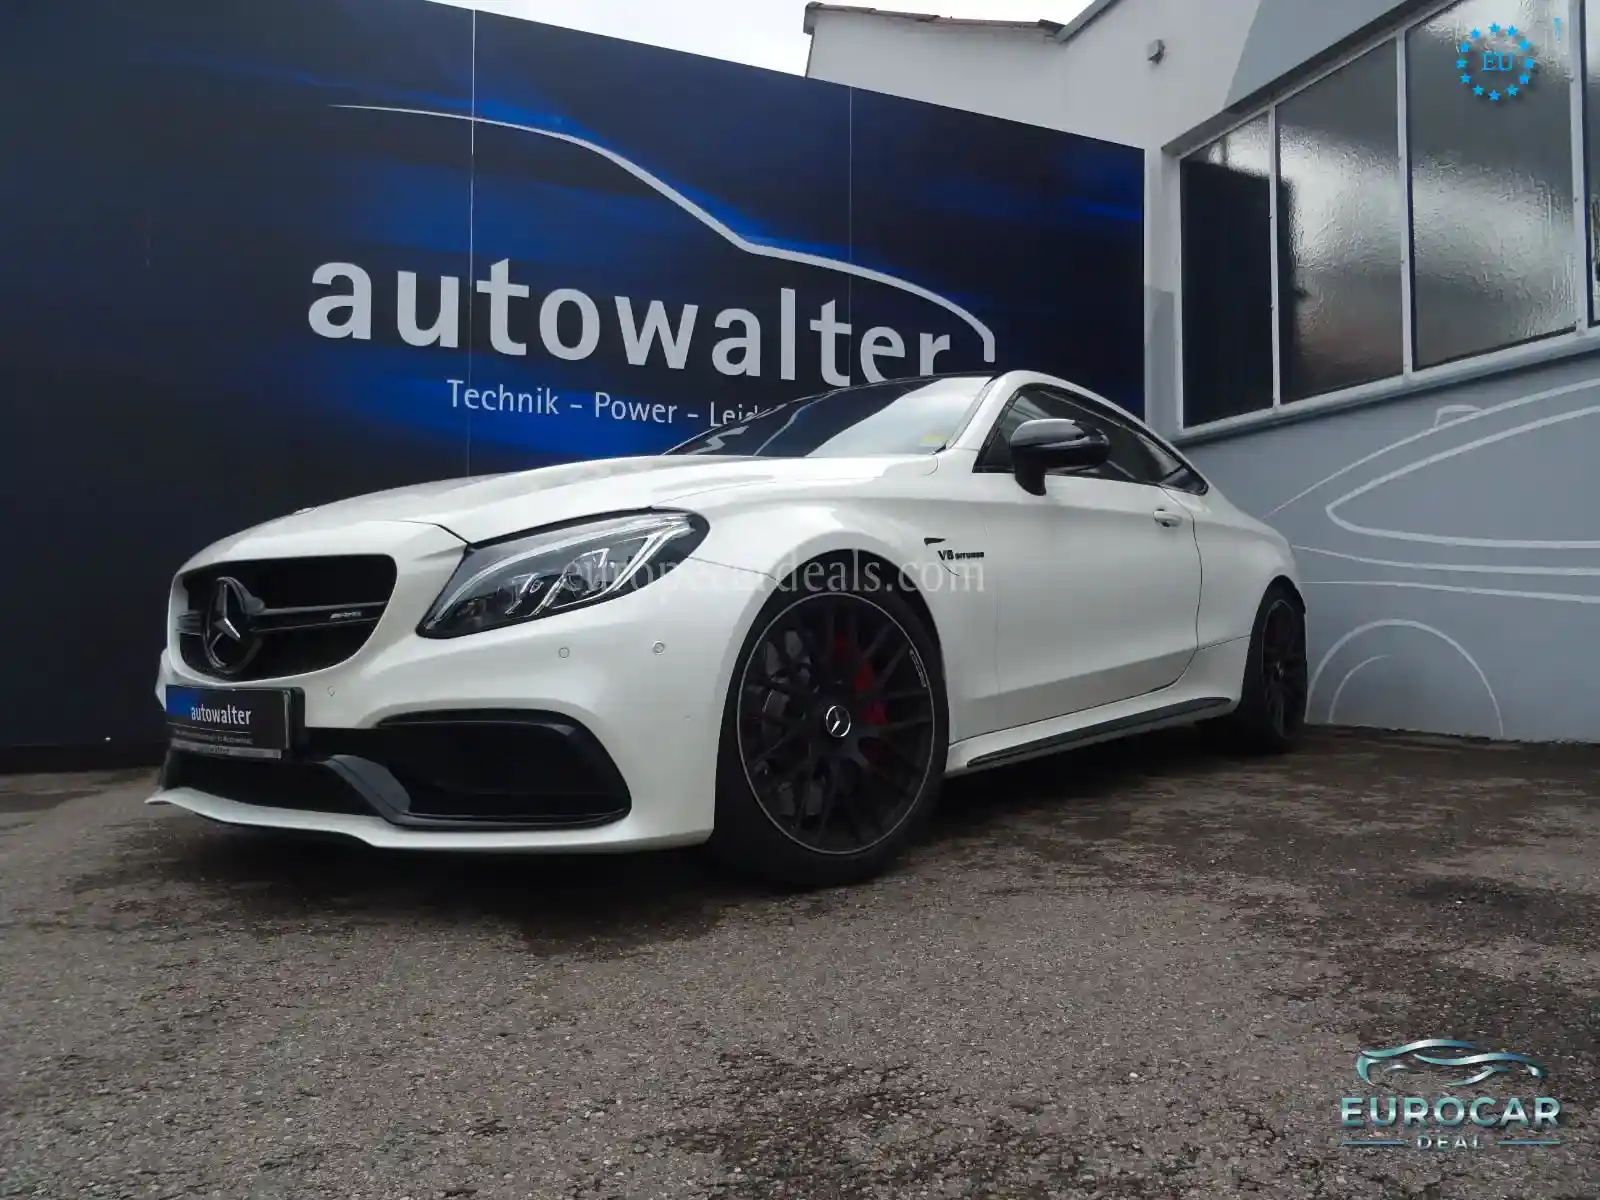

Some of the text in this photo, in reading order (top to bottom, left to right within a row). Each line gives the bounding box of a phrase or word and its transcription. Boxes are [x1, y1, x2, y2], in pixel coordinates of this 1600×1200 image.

[308, 258, 951, 386] autowalter
[447, 379, 559, 415] Technik
[595, 391, 678, 424] Power
[191, 704, 252, 725] autowalter
